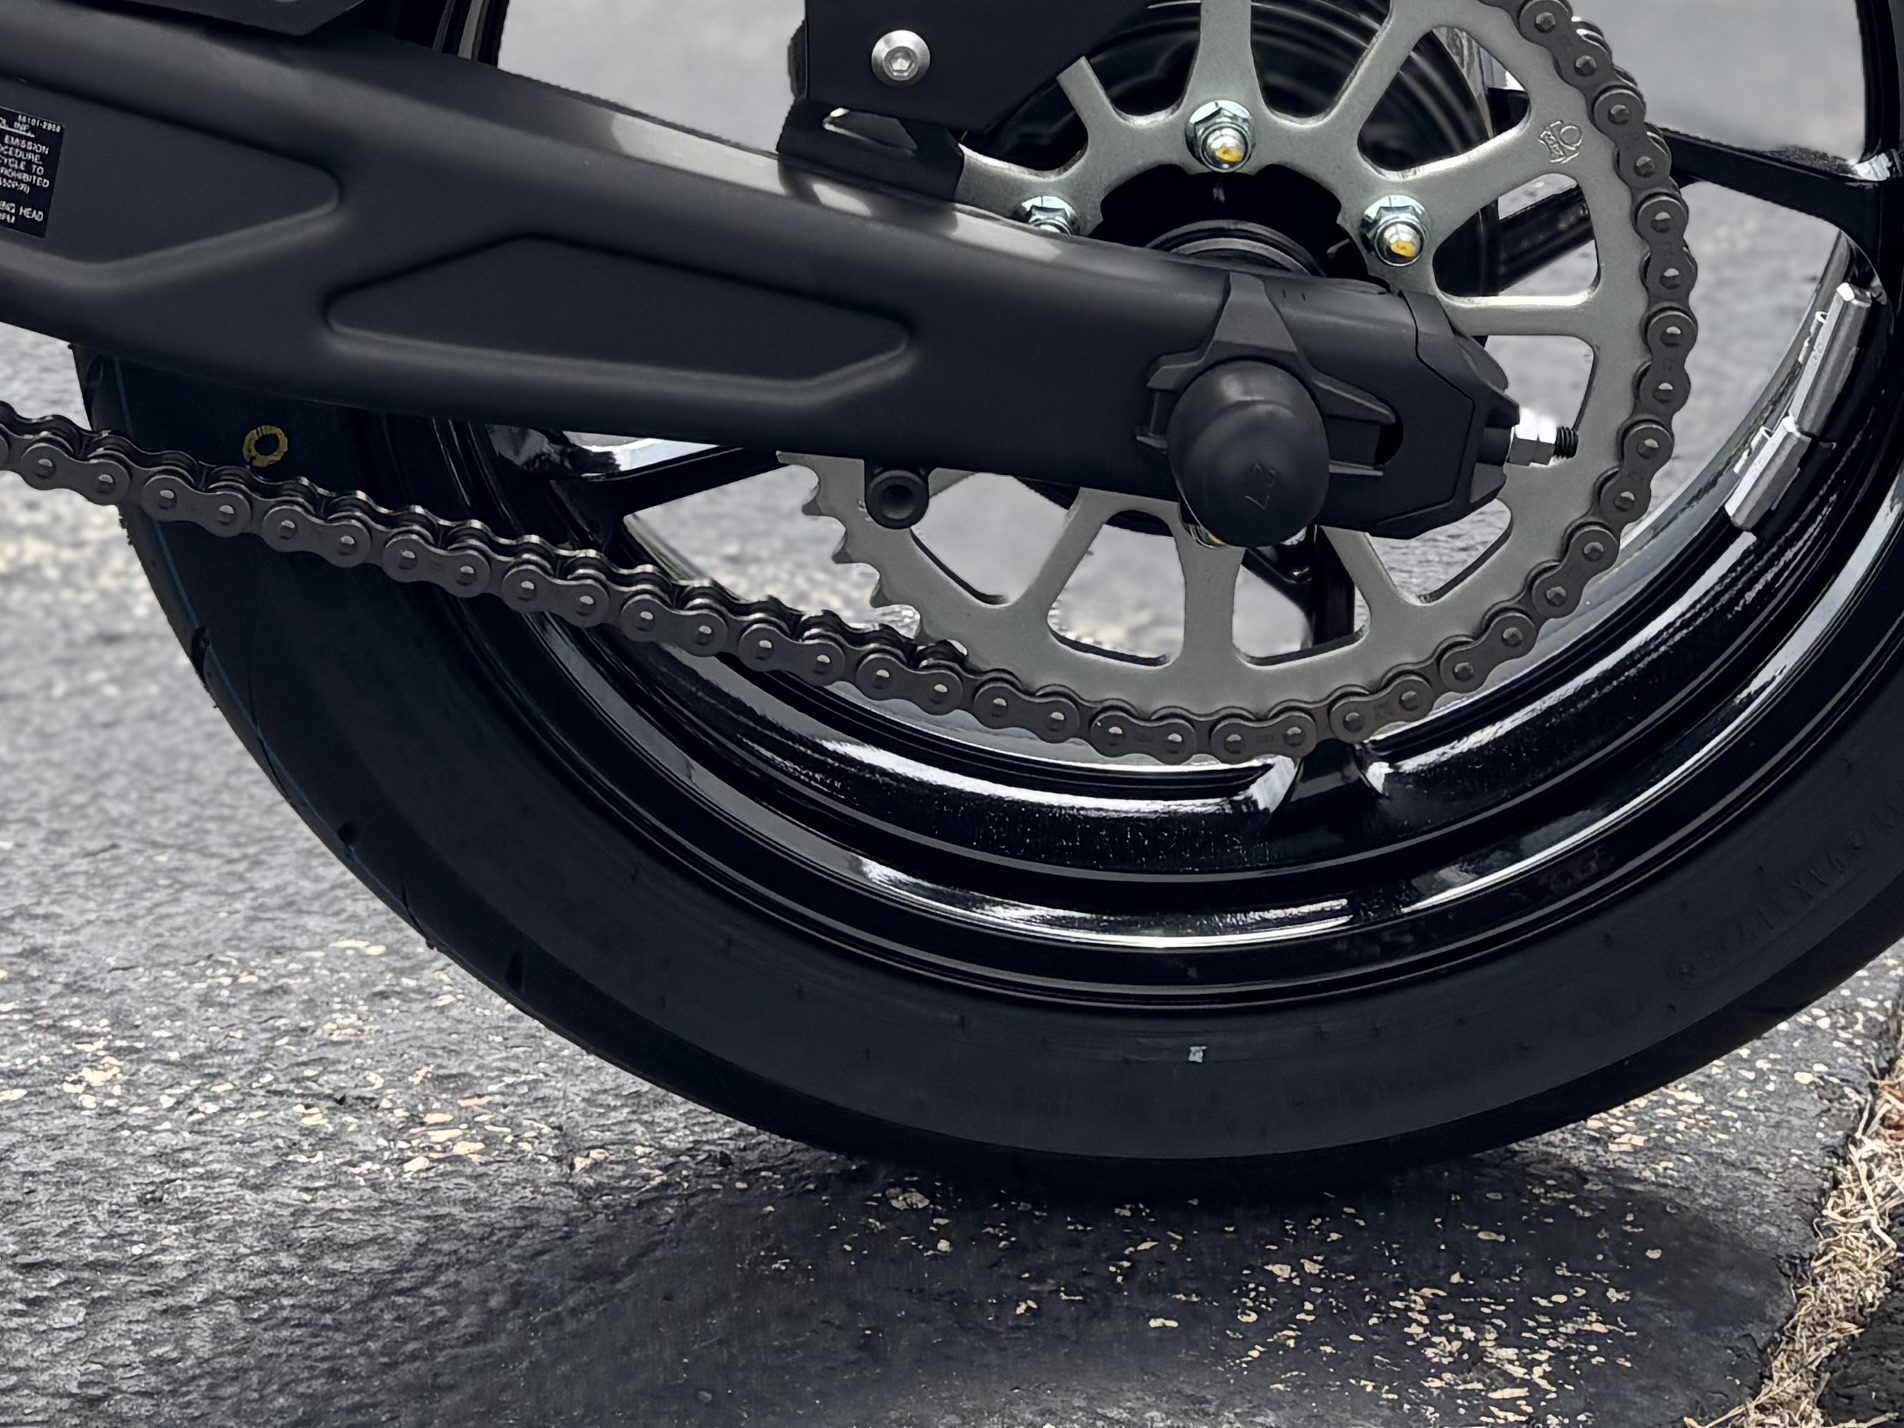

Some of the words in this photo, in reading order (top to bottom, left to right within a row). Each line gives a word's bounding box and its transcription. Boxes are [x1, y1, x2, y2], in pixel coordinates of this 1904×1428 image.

[4, 134, 48, 155] EMISSION
[31, 164, 44, 176] TO
[18, 205, 43, 222] HEAD
